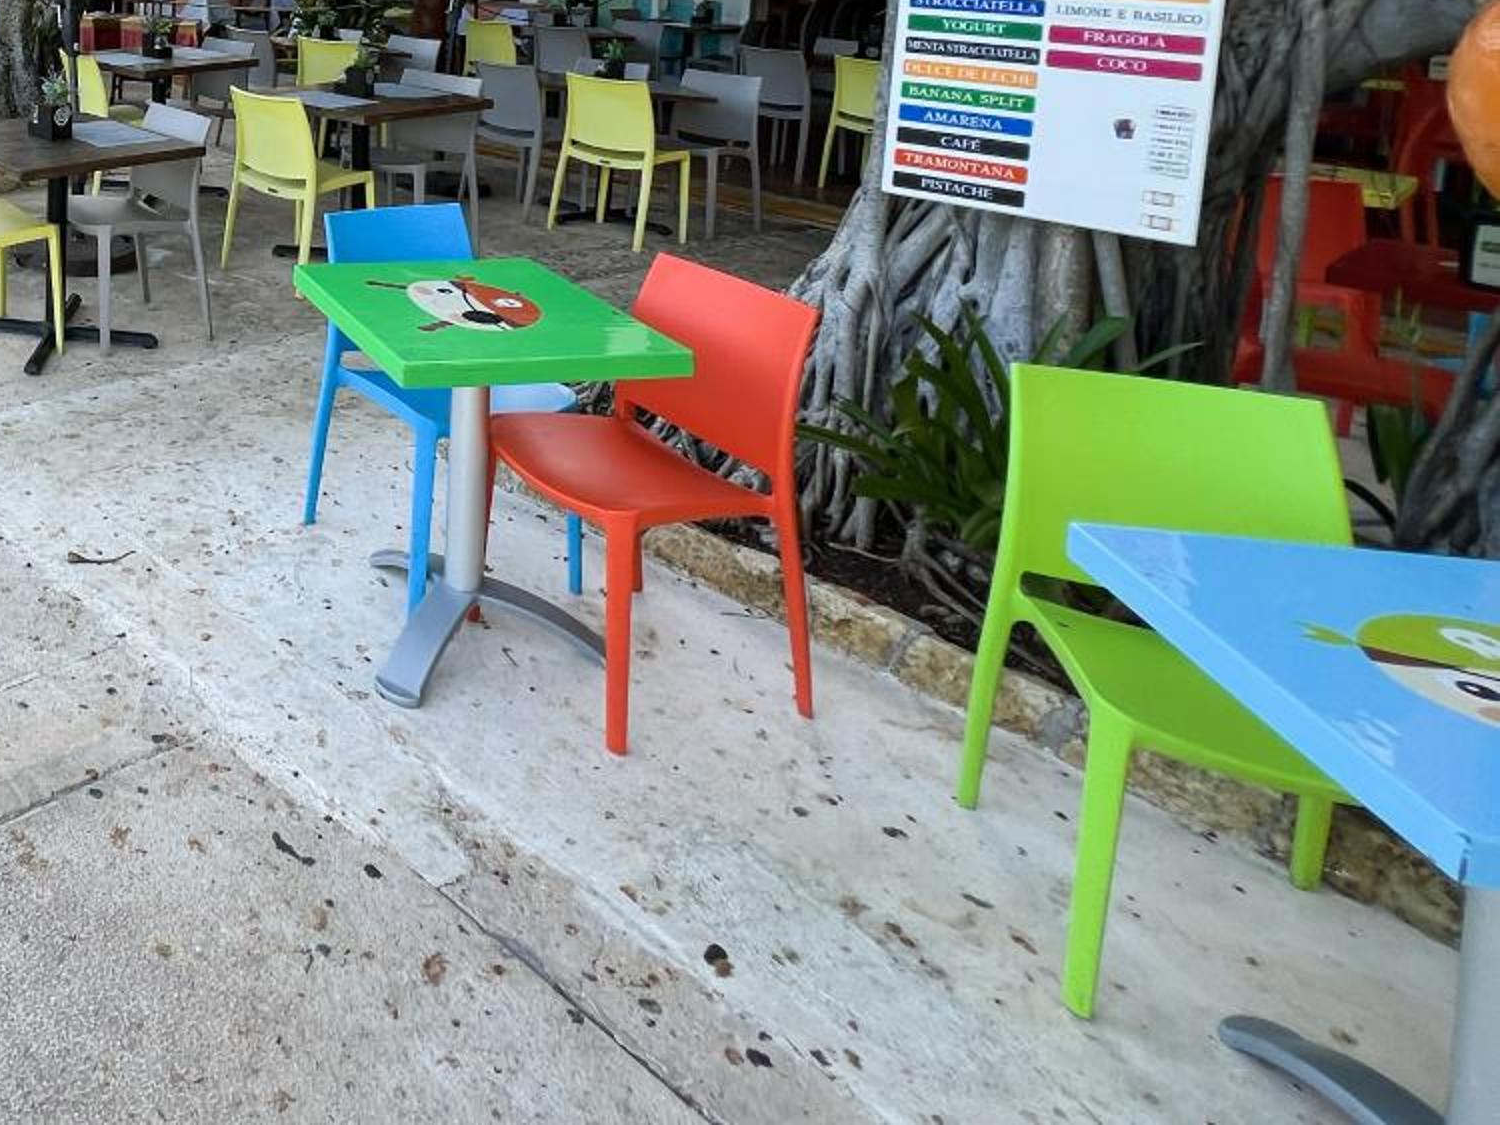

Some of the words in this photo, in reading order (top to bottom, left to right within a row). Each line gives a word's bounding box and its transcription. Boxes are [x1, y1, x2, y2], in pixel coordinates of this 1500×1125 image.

[1055, 4, 1113, 19] LIMONE
[1118, 10, 1127, 20] E
[1133, 10, 1204, 25] BASILICO
[942, 19, 1007, 34] YOGURT
[907, 39, 945, 53] MENTA
[945, 43, 1038, 61] STRACCIATELLA
[1083, 31, 1167, 49] FRAGOLA
[905, 61, 957, 77] DULCE
[960, 65, 979, 78] DE
[982, 69, 1033, 85] LECHE
[1096, 57, 1148, 72] COCO
[909, 85, 973, 103] BANANA
[979, 94, 1027, 108] SPLIT
[923, 110, 1003, 131] AMARENA
[903, 152, 1016, 180] TRAMONTANA
[920, 177, 995, 200] PISTACHE
